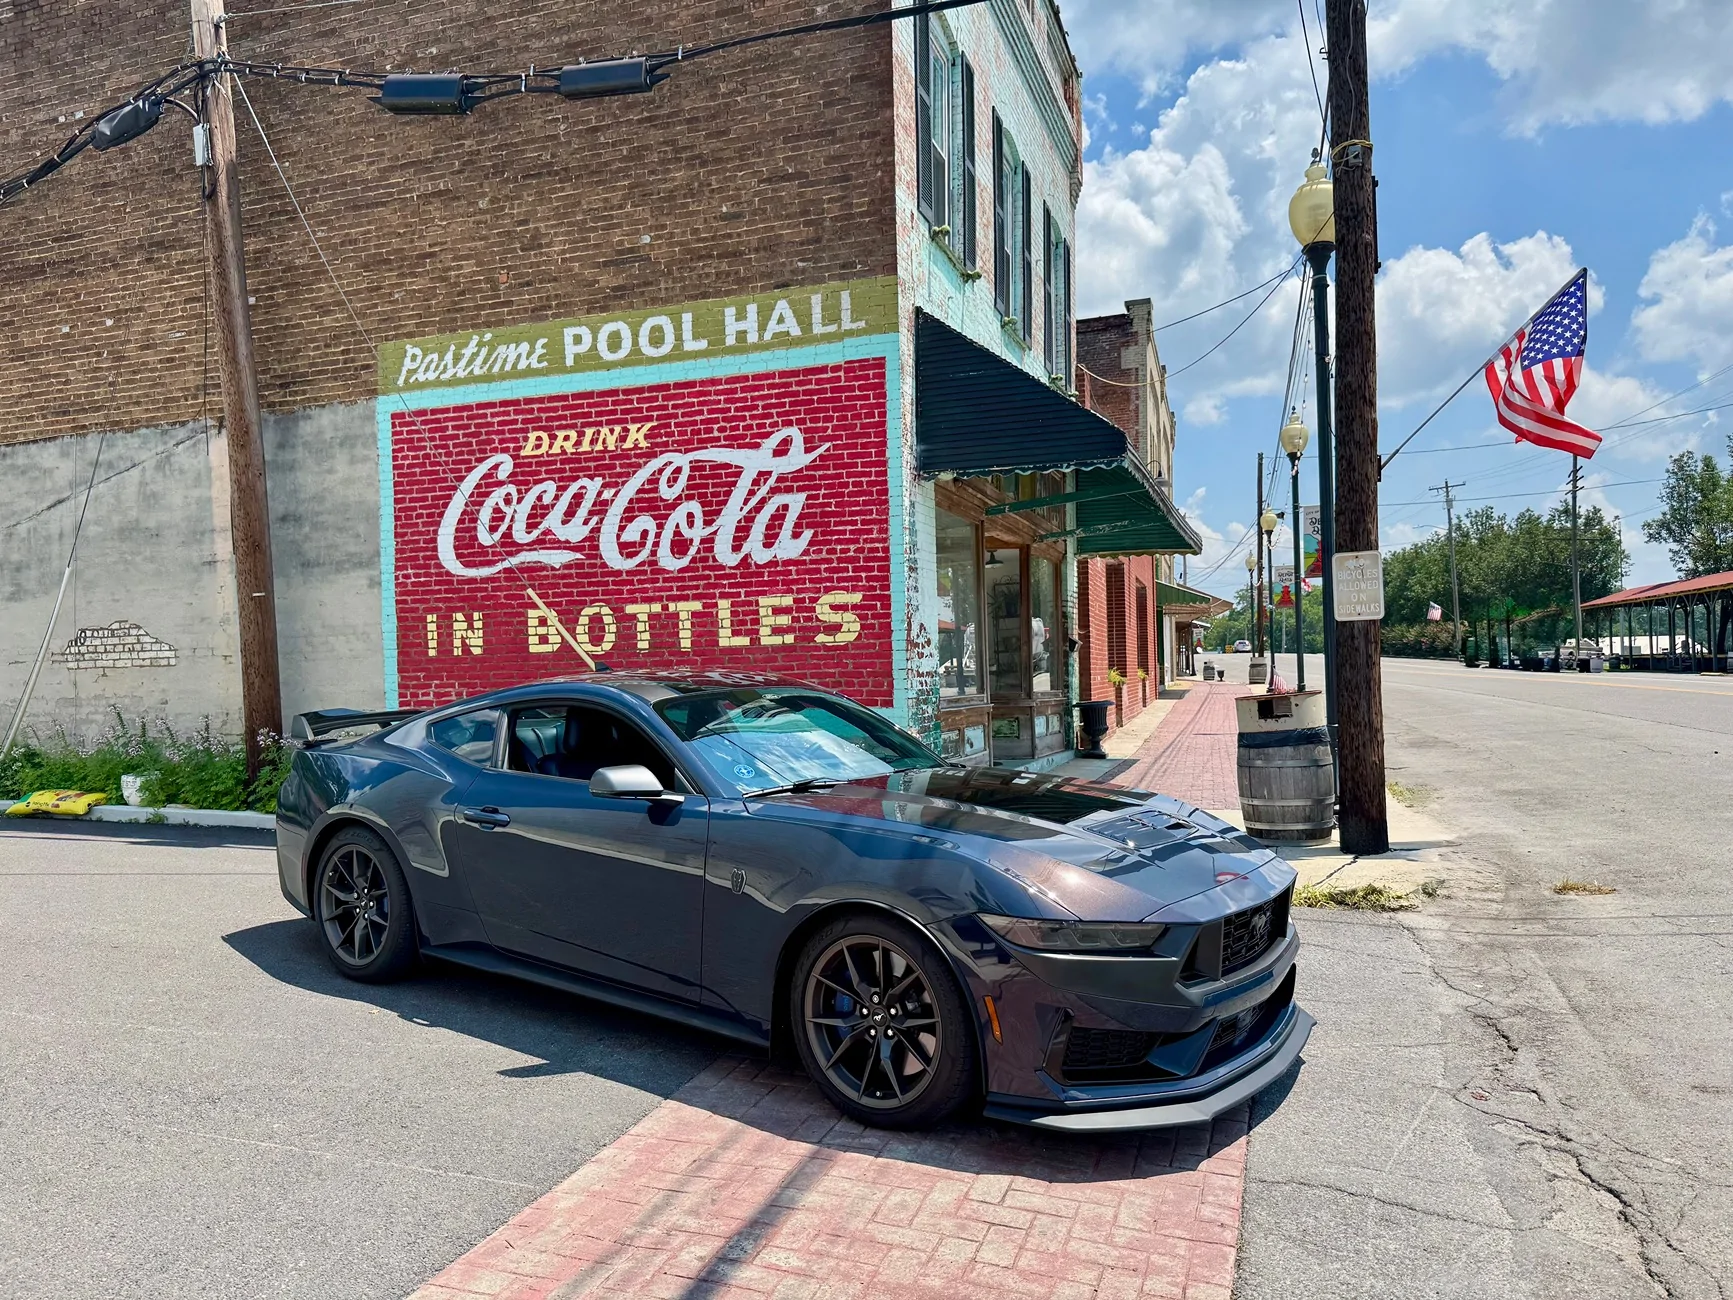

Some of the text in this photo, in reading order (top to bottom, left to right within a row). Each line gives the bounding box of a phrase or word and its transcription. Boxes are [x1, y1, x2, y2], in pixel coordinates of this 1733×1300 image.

[397, 290, 867, 387] Pastime POOL HALL
[520, 422, 658, 456] DRINK
[1337, 569, 1378, 580] BICYCLES
[1338, 581, 1379, 591] ALLOWED
[1351, 593, 1367, 602] ON
[1338, 603, 1380, 614] SIDEWALKS
[427, 590, 863, 657] IN BOTTLES
